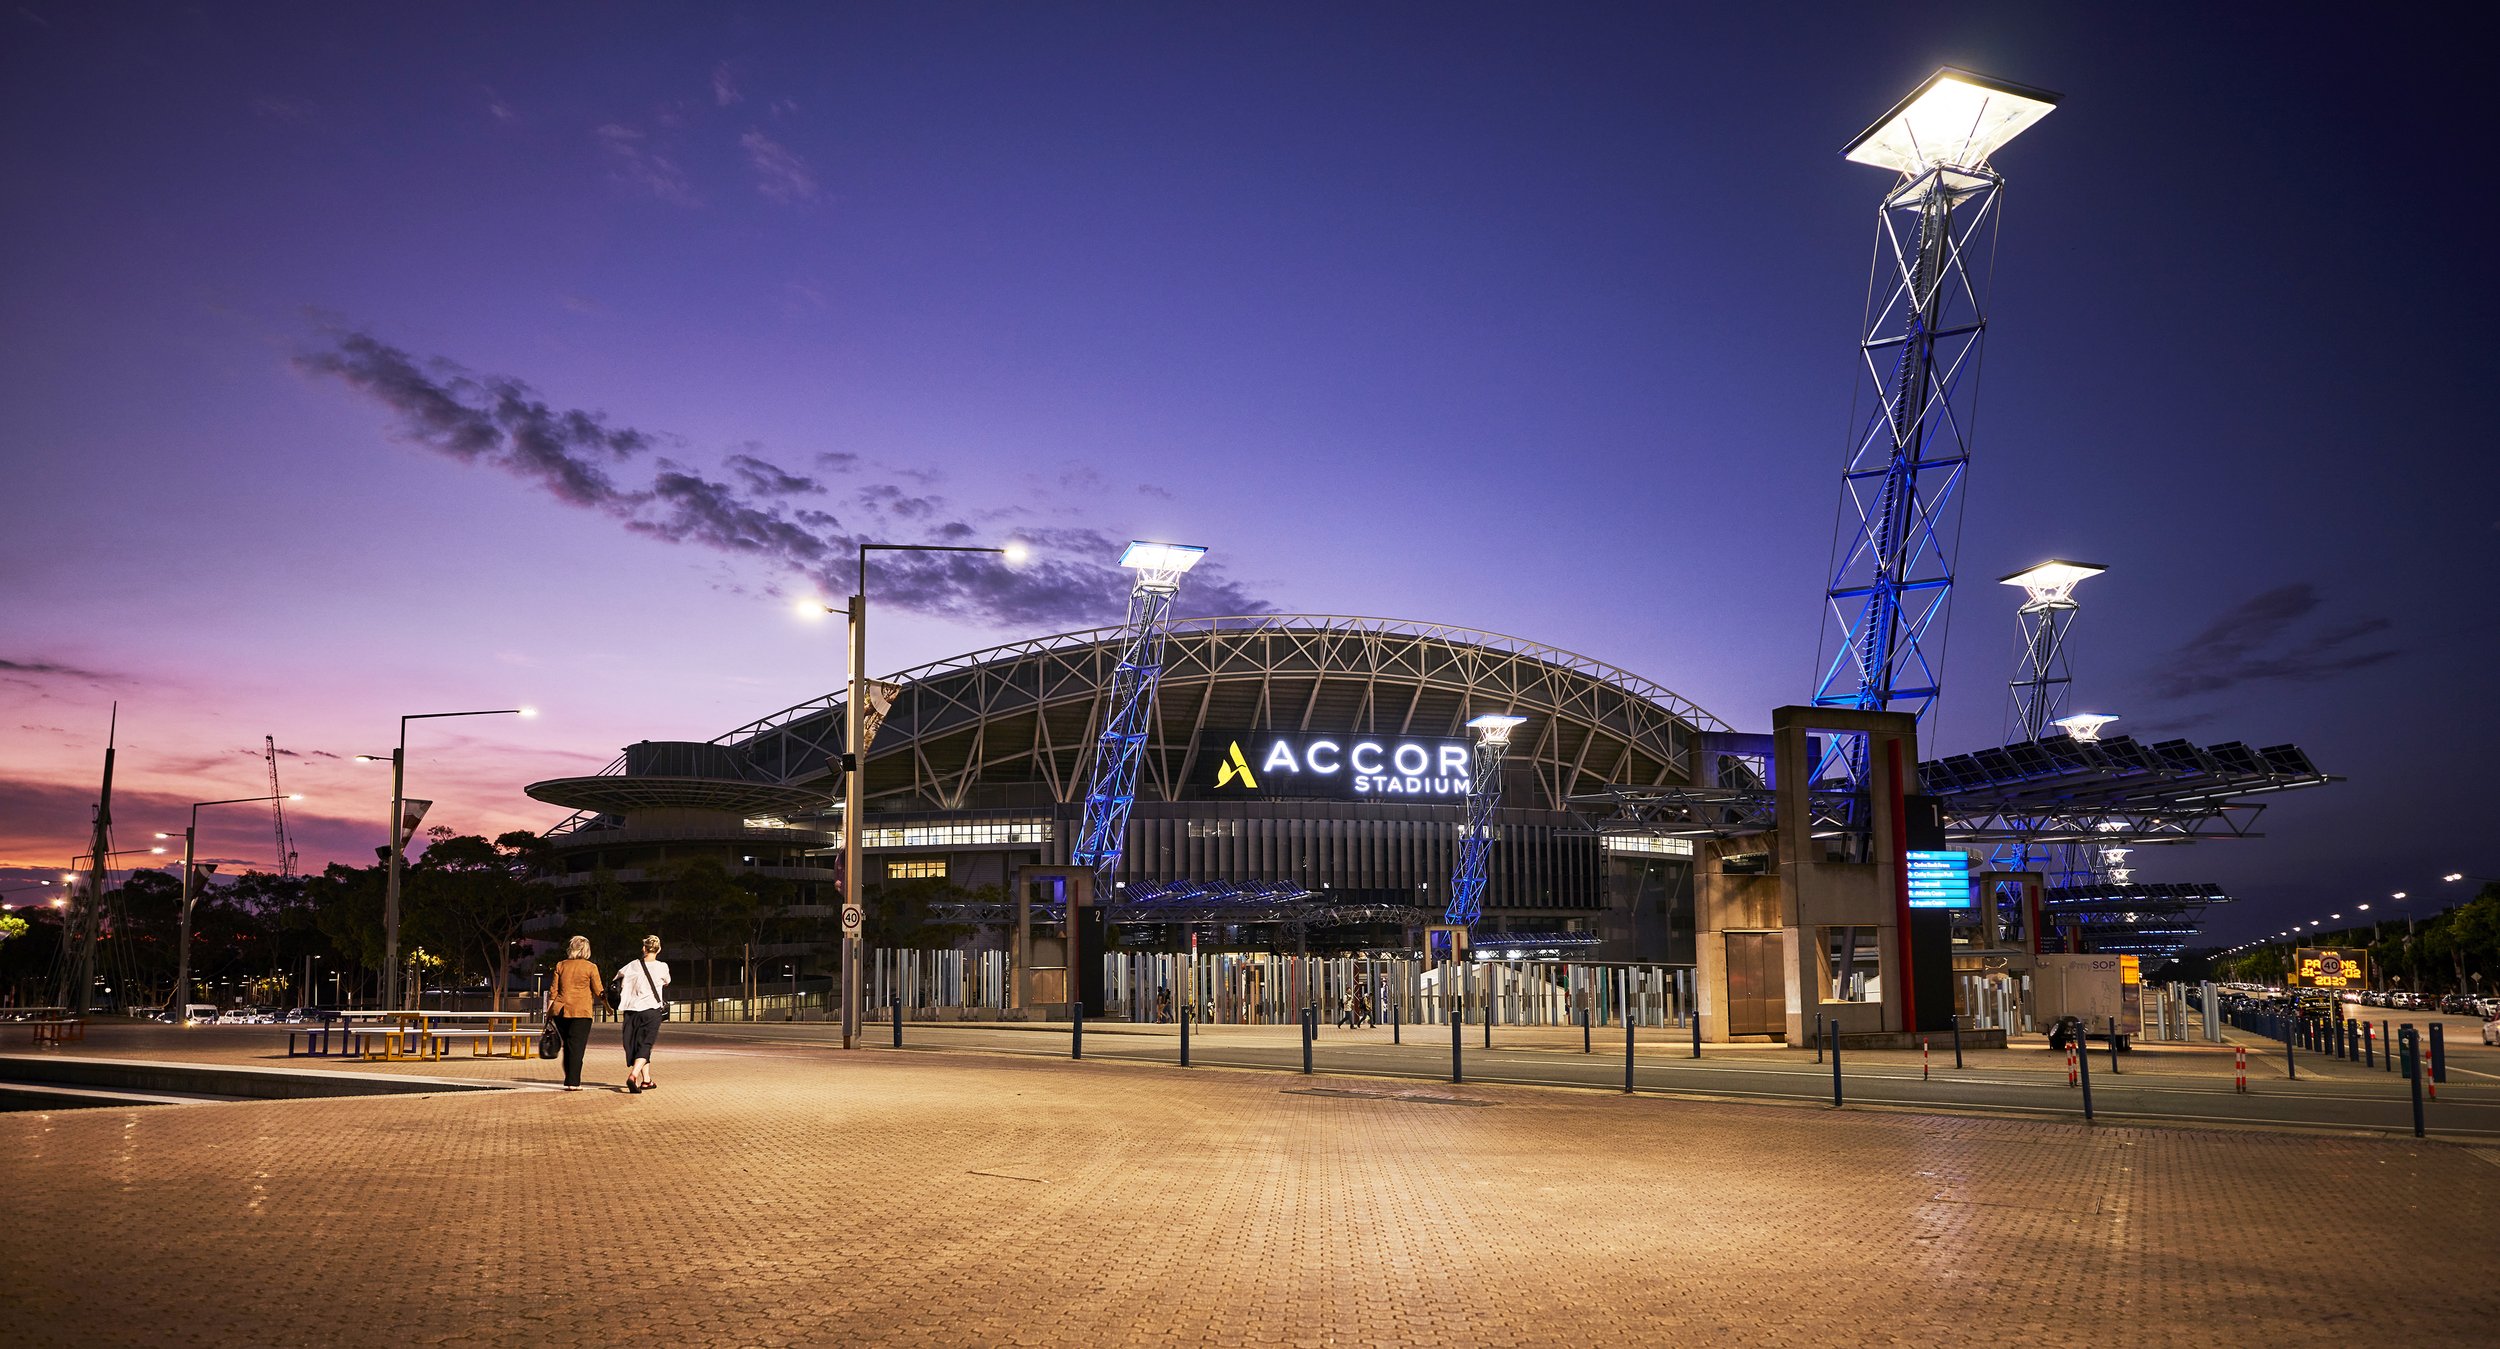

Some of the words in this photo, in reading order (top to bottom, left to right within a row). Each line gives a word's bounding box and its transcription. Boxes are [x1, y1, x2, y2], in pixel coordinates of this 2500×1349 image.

[1264, 740, 1469, 777] ACCOR
[1354, 775, 1470, 794] STADIUM
[1931, 804, 1939, 828] 1
[845, 913, 857, 923] 40
[1095, 910, 1101, 922] 2
[2323, 961, 2338, 970] 40
[2314, 977, 2347, 986] 2023
